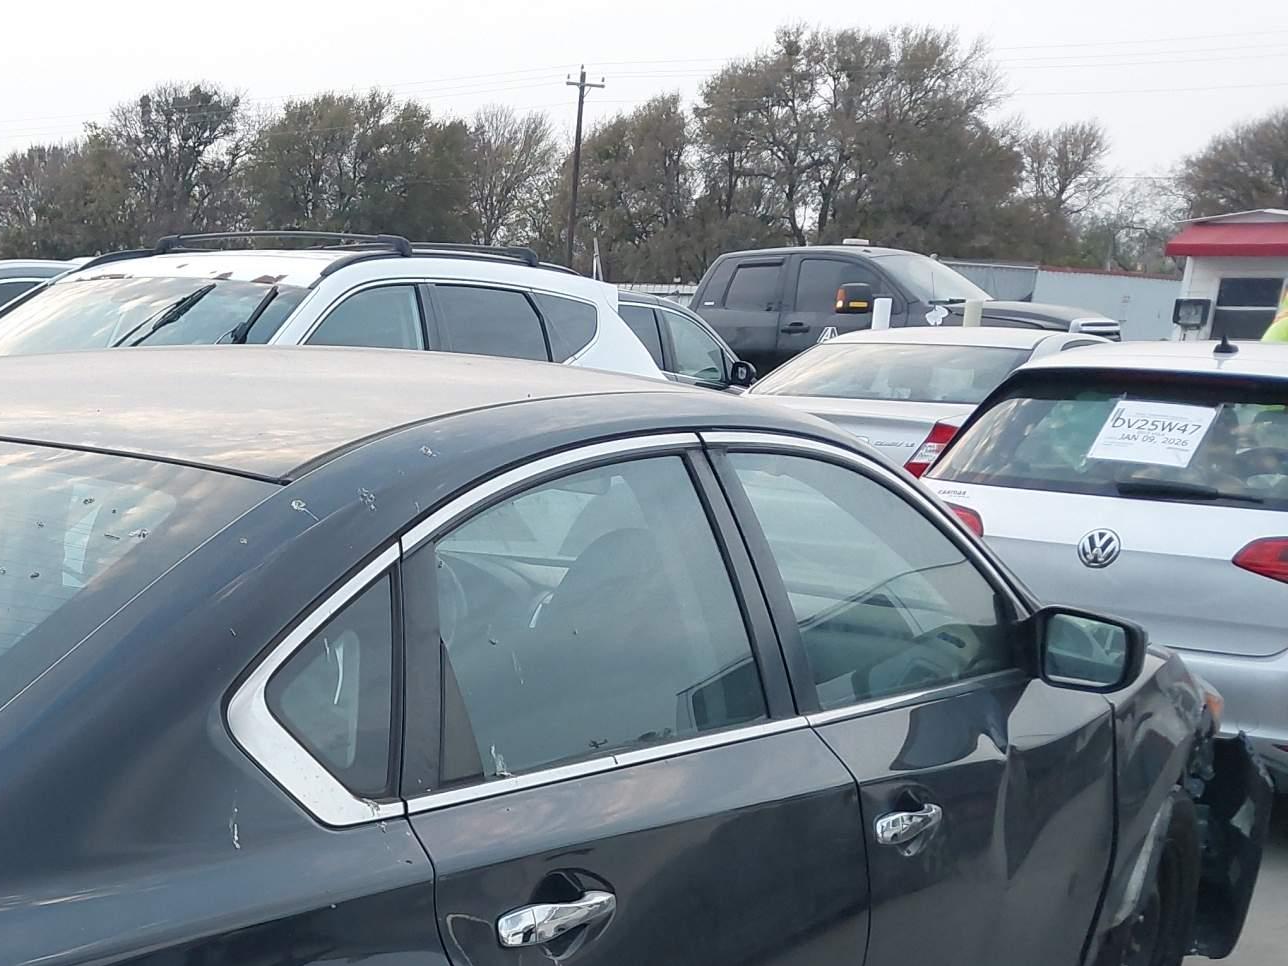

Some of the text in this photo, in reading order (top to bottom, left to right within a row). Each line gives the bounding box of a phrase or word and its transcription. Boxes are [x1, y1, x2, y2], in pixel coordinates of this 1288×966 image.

[1118, 433, 1139, 441] JAN
[1142, 435, 1158, 444] 09,
[1161, 437, 1190, 447] 2026
